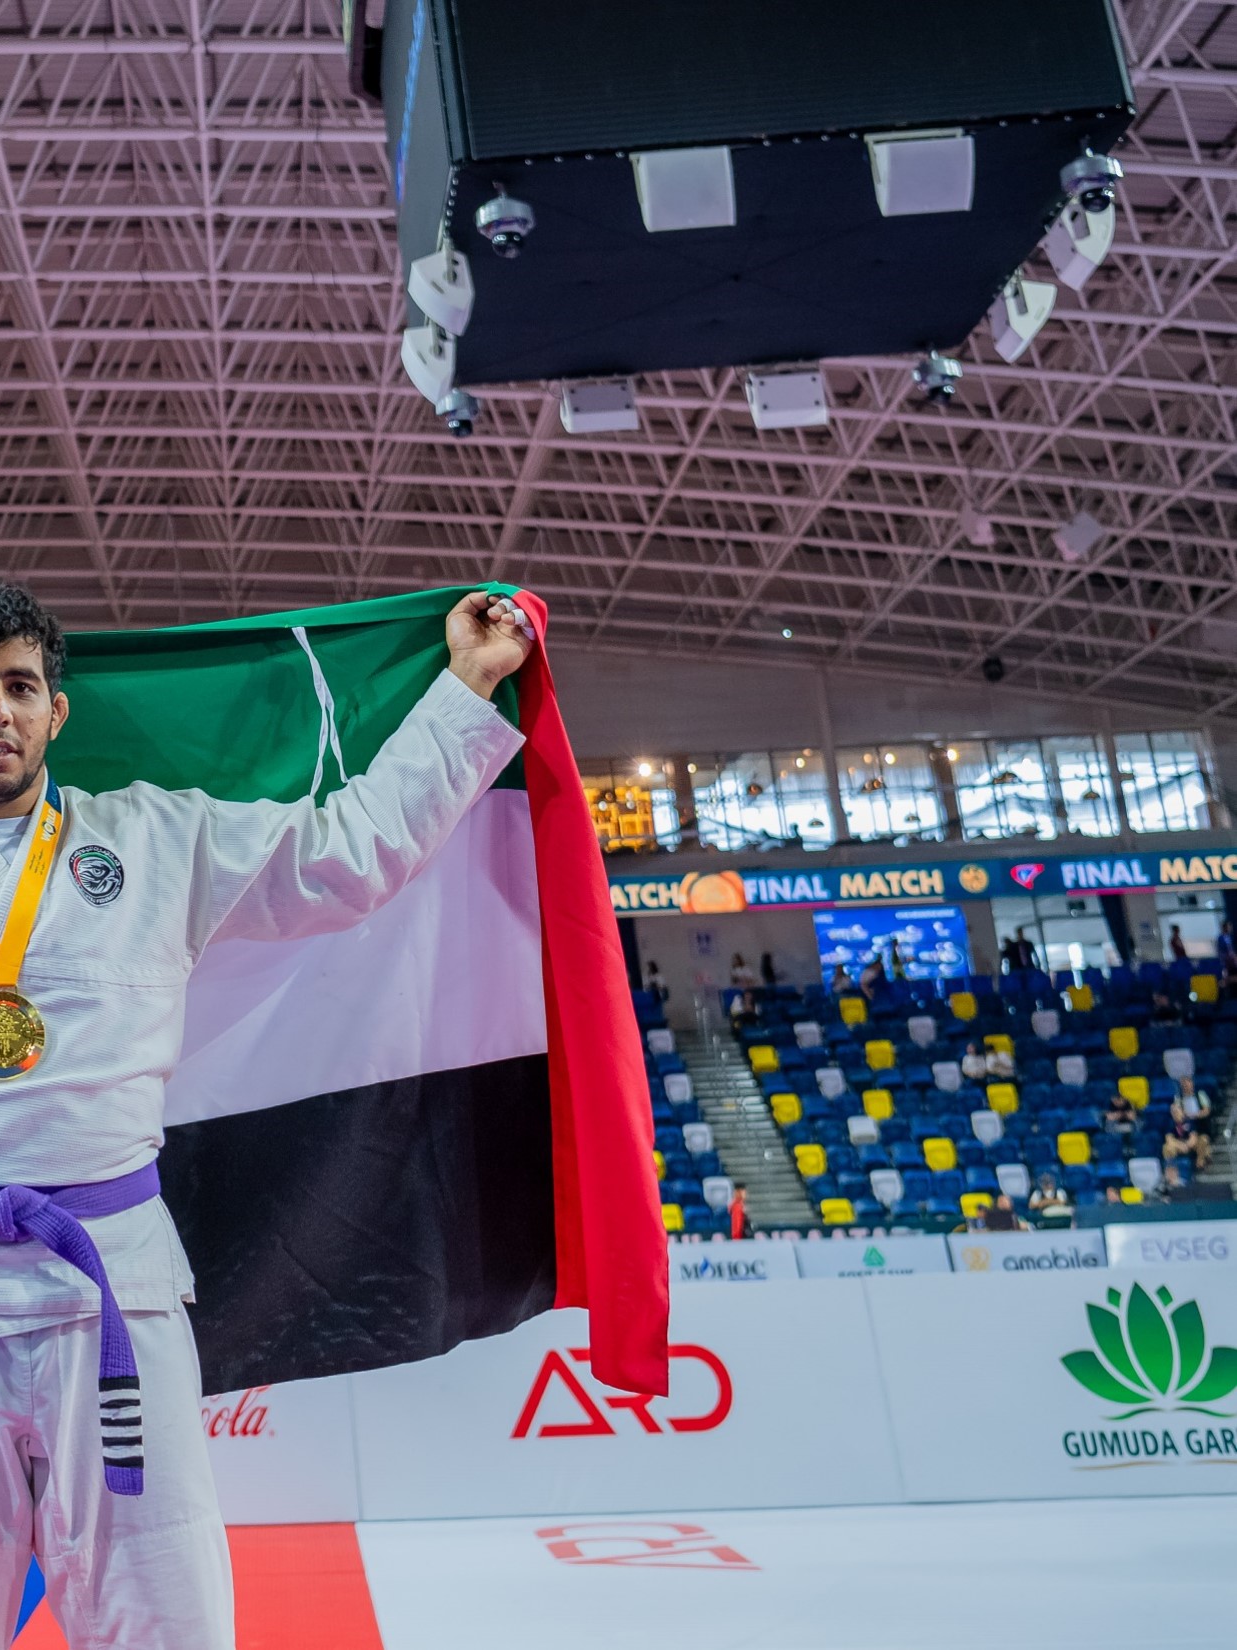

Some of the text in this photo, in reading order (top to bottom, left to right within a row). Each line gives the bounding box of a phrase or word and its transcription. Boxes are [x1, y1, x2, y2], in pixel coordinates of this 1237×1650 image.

[40, 807, 57, 842] WORLD
[743, 869, 944, 904] FINAL MATCH
[1061, 859, 1150, 889] FINAL
[1003, 1246, 1100, 1271] amobile
[1140, 1236, 1229, 1261] EVSEG
[1063, 1428, 1179, 1457] GUMUDA
